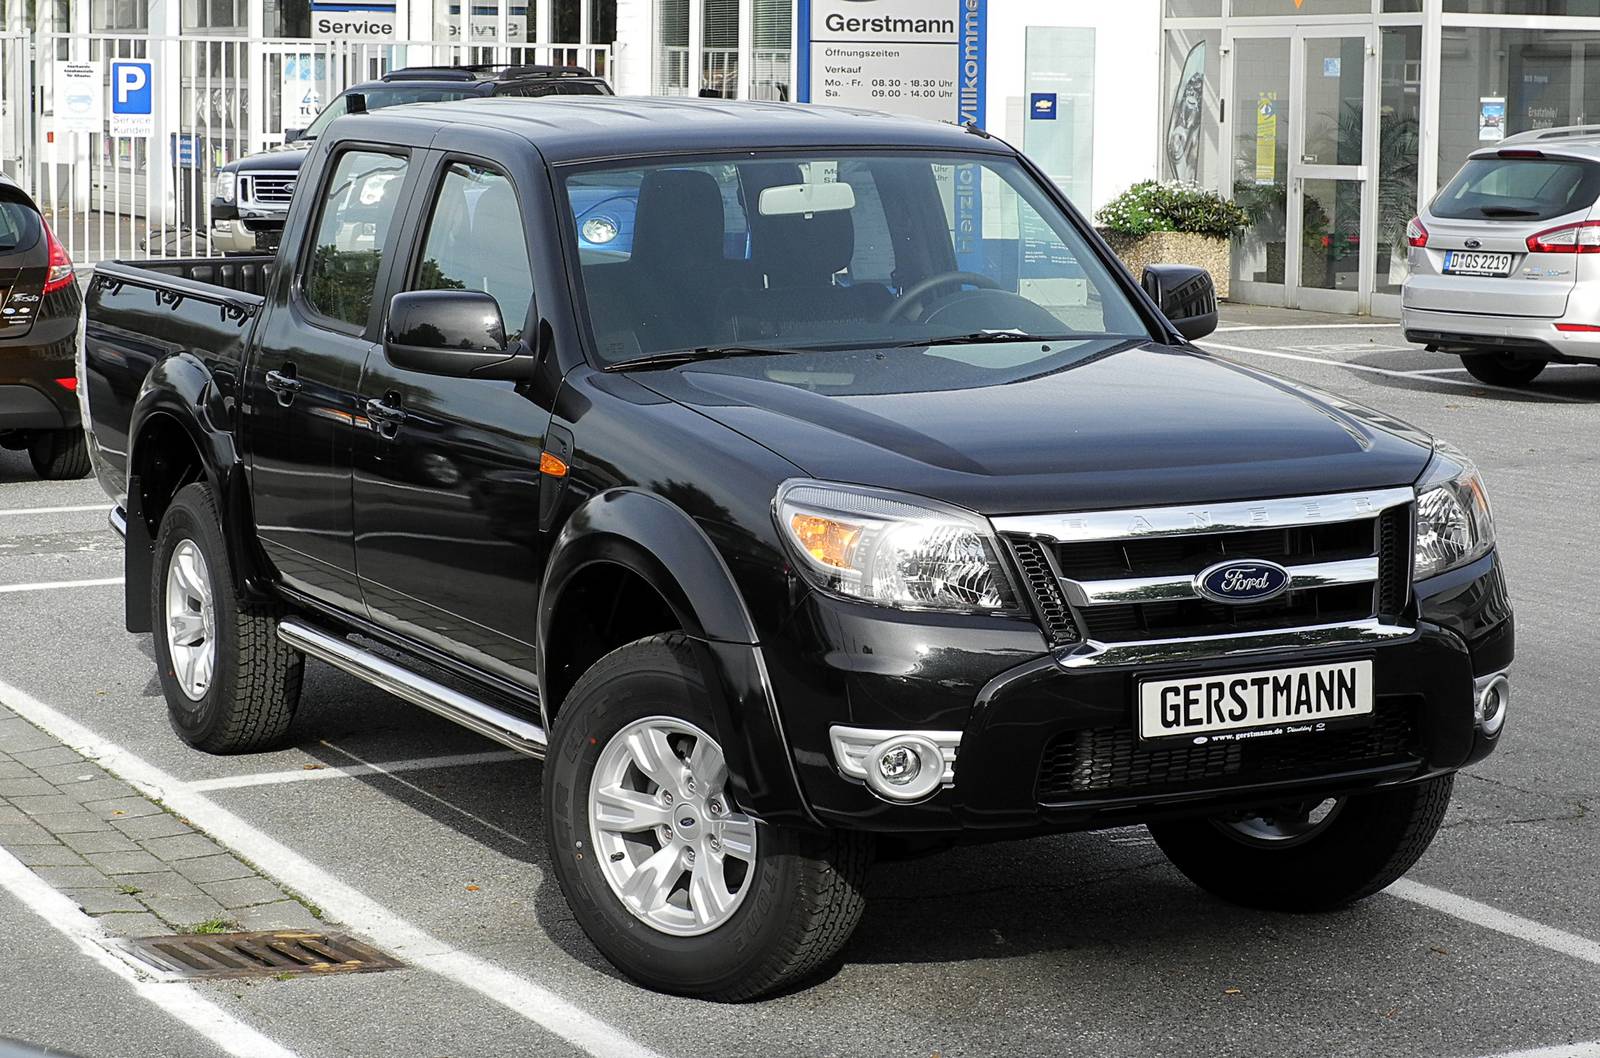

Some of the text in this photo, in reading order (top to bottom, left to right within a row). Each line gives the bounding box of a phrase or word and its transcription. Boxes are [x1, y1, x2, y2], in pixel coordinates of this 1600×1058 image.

[318, 19, 393, 35] Service
[825, 13, 954, 33] Gerstmann
[825, 48, 900, 58] Öffnungszeiten
[825, 65, 862, 74] Verkauf
[118, 66, 146, 103] P
[824, 79, 844, 87] Mo.
[851, 79, 864, 87] Fr.
[871, 79, 901, 87] 08.30
[910, 79, 936, 87] 18.30
[938, 79, 953, 87] Uhr
[825, 89, 841, 97] Sa.
[871, 89, 901, 98] 09.00
[910, 90, 936, 98] 14.00
[938, 90, 953, 98] Uhr
[1451, 254, 1459, 268] D
[1061, 496, 1372, 532] RANGER
[1221, 568, 1270, 593] Ford
[1160, 667, 1357, 730] GERSTMANN
